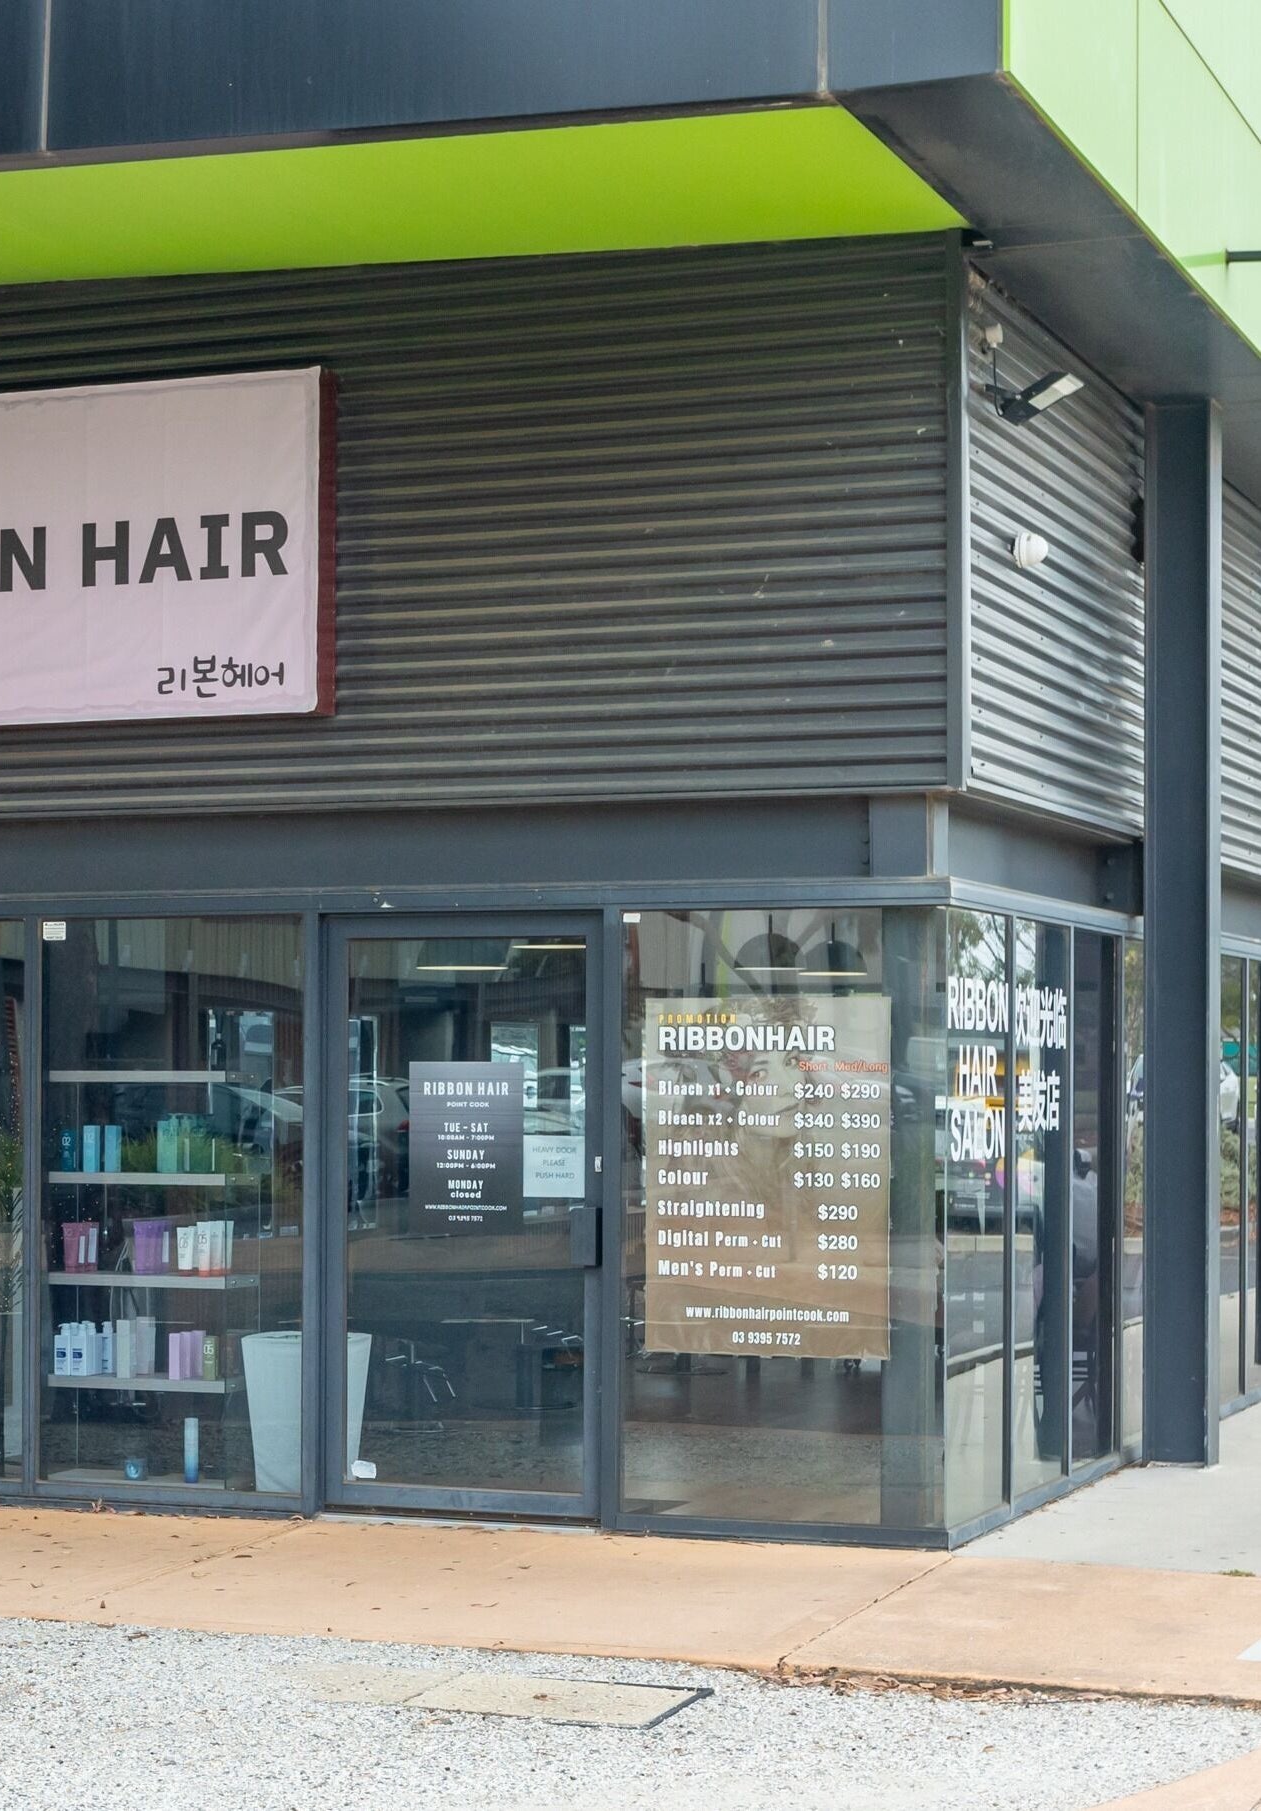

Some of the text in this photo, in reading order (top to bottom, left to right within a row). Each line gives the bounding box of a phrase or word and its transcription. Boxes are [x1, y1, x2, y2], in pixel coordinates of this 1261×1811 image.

[82, 510, 289, 588] HAIR
[157, 656, 285, 697] 리본헤어
[947, 976, 1009, 1033] RIBBON
[658, 1013, 737, 1024] PROMOTION
[1015, 983, 1068, 1050] 欢迎光临
[658, 1025, 836, 1051] RIBBONHAIR
[798, 1060, 888, 1075] Short Med/Long
[959, 1044, 998, 1097] HAIR
[423, 1081, 509, 1096] RIBBON HAIR
[658, 1080, 703, 1096] Bleach
[708, 1083, 721, 1096] x1
[735, 1081, 779, 1097] Colour
[794, 1083, 835, 1100] $240
[841, 1083, 881, 1100] $290
[1018, 1069, 1061, 1132] 美发店
[444, 1122, 461, 1133] TUE
[470, 1123, 489, 1133] SAT
[658, 1110, 703, 1126] Bleach
[708, 1113, 723, 1127] x2
[737, 1111, 781, 1127] Colour
[794, 1112, 835, 1130] $340
[841, 1113, 881, 1130] $390
[950, 1107, 1006, 1162] SALON
[447, 1149, 485, 1160] SUNDAY
[533, 1146, 577, 1154] HEAVY DOOR
[658, 1139, 881, 1160] Highlights $150 $190
[543, 1159, 566, 1167] PLEASE
[448, 1180, 484, 1190] MONDAY
[535, 1171, 575, 1180] PUSH HARD
[658, 1169, 881, 1189] Colour $130 $160
[450, 1191, 482, 1199] closed
[658, 1200, 859, 1221] Straightening $290
[658, 1229, 709, 1248] Digital
[715, 1231, 749, 1247] Perm
[817, 1234, 859, 1251] $280
[658, 1260, 703, 1276] Men's
[709, 1261, 743, 1278] Perm
[817, 1264, 859, 1281] $120
[685, 1305, 850, 1323] www.ribbonhairpointcook.com
[732, 1331, 801, 1346] 03 9395 7572
